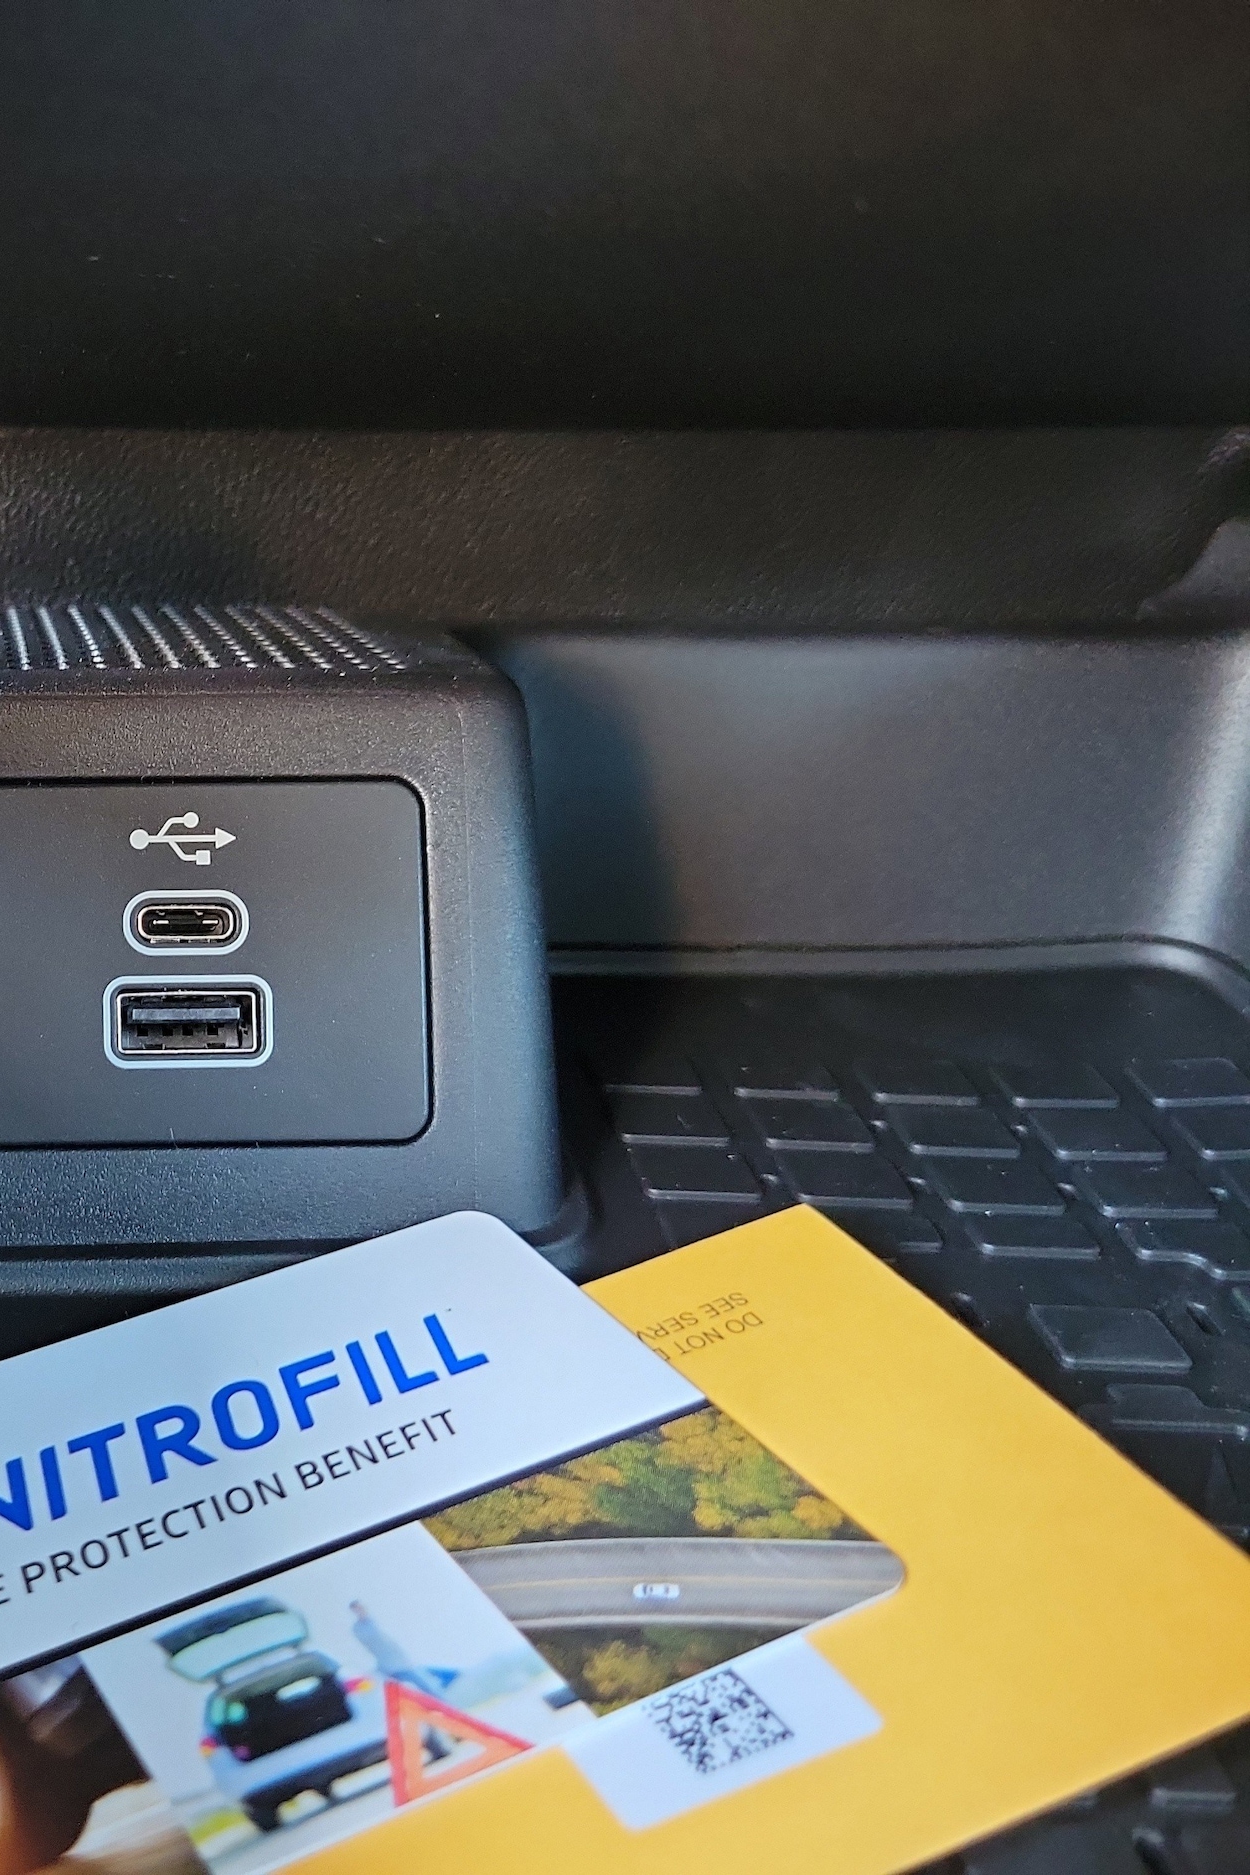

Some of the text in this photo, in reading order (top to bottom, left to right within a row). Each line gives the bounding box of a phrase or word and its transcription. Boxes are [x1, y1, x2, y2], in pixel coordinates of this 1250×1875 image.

[698, 1291, 749, 1319] SEE
[725, 1311, 764, 1335] DO
[673, 1328, 725, 1357] NOT
[20, 1473, 287, 1594] PROTECTION
[294, 1408, 456, 1490] BENEFIT
